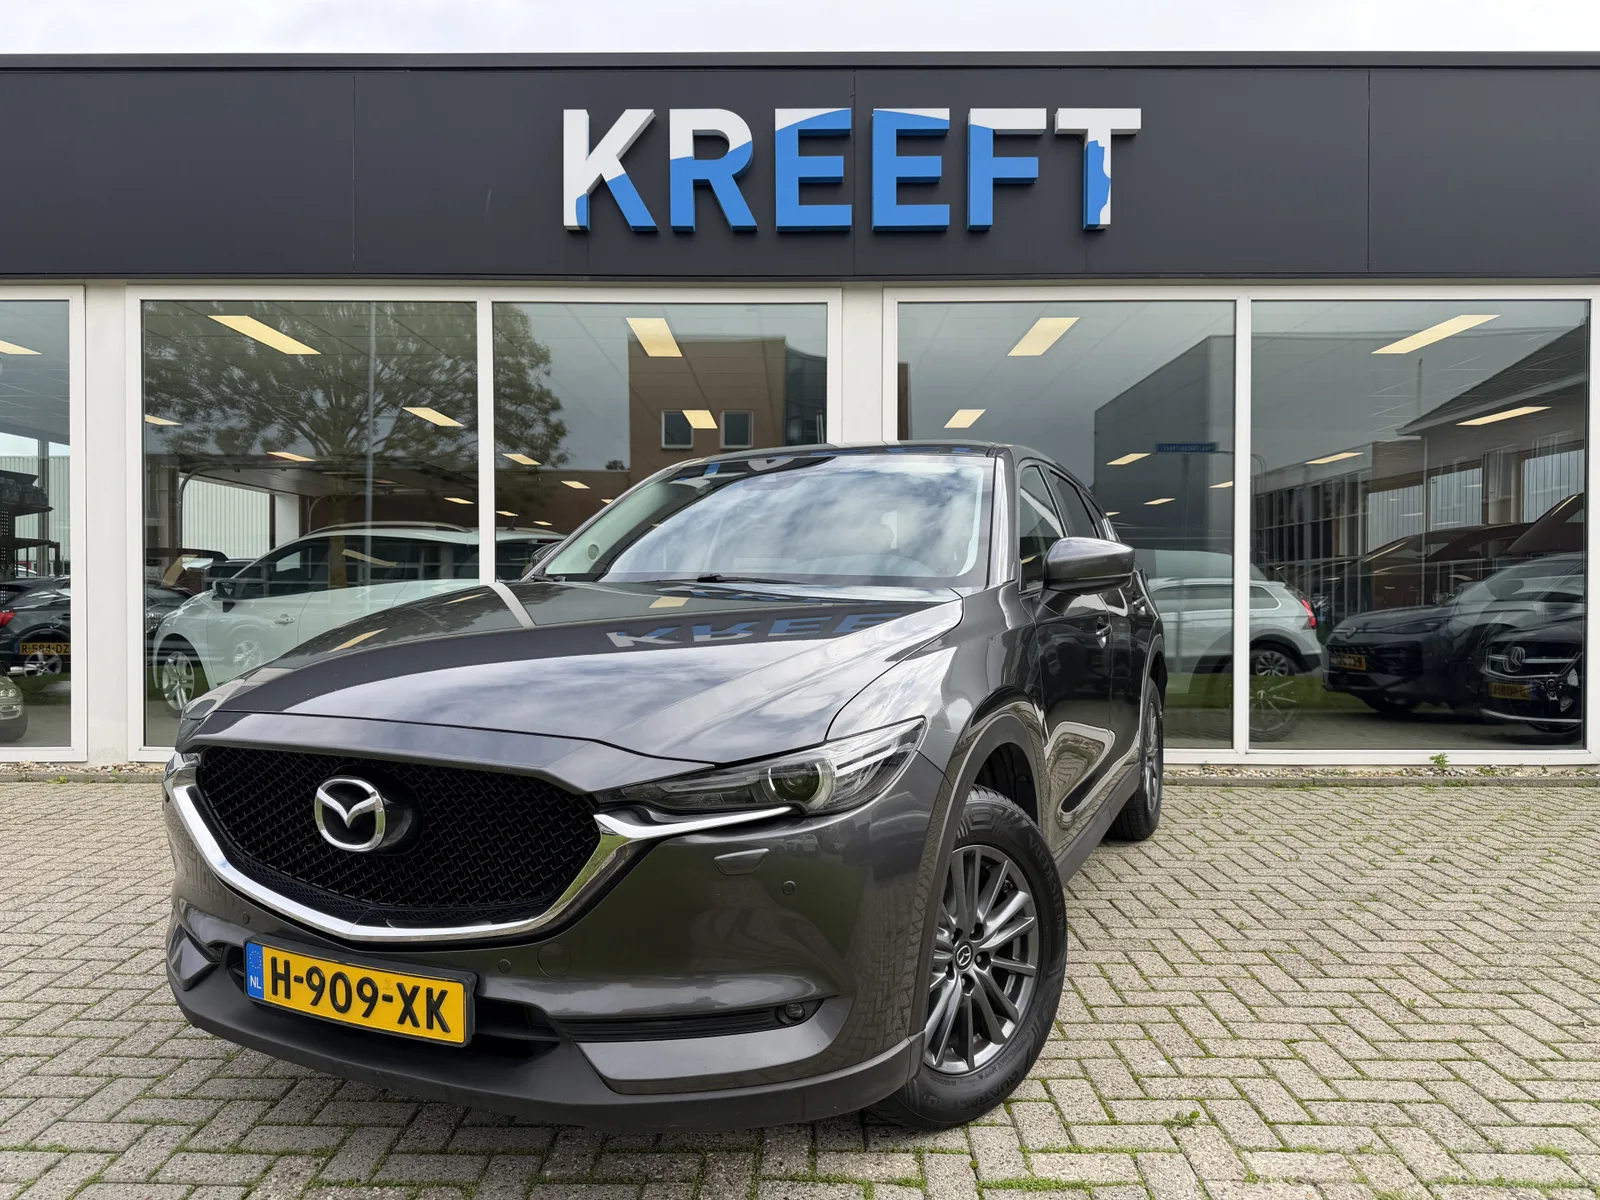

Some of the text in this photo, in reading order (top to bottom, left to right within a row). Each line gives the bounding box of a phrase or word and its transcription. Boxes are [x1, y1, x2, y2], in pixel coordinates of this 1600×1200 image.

[563, 108, 1142, 231] KREEFT
[249, 975, 262, 990] NL
[270, 956, 451, 1034] H-909-XK
